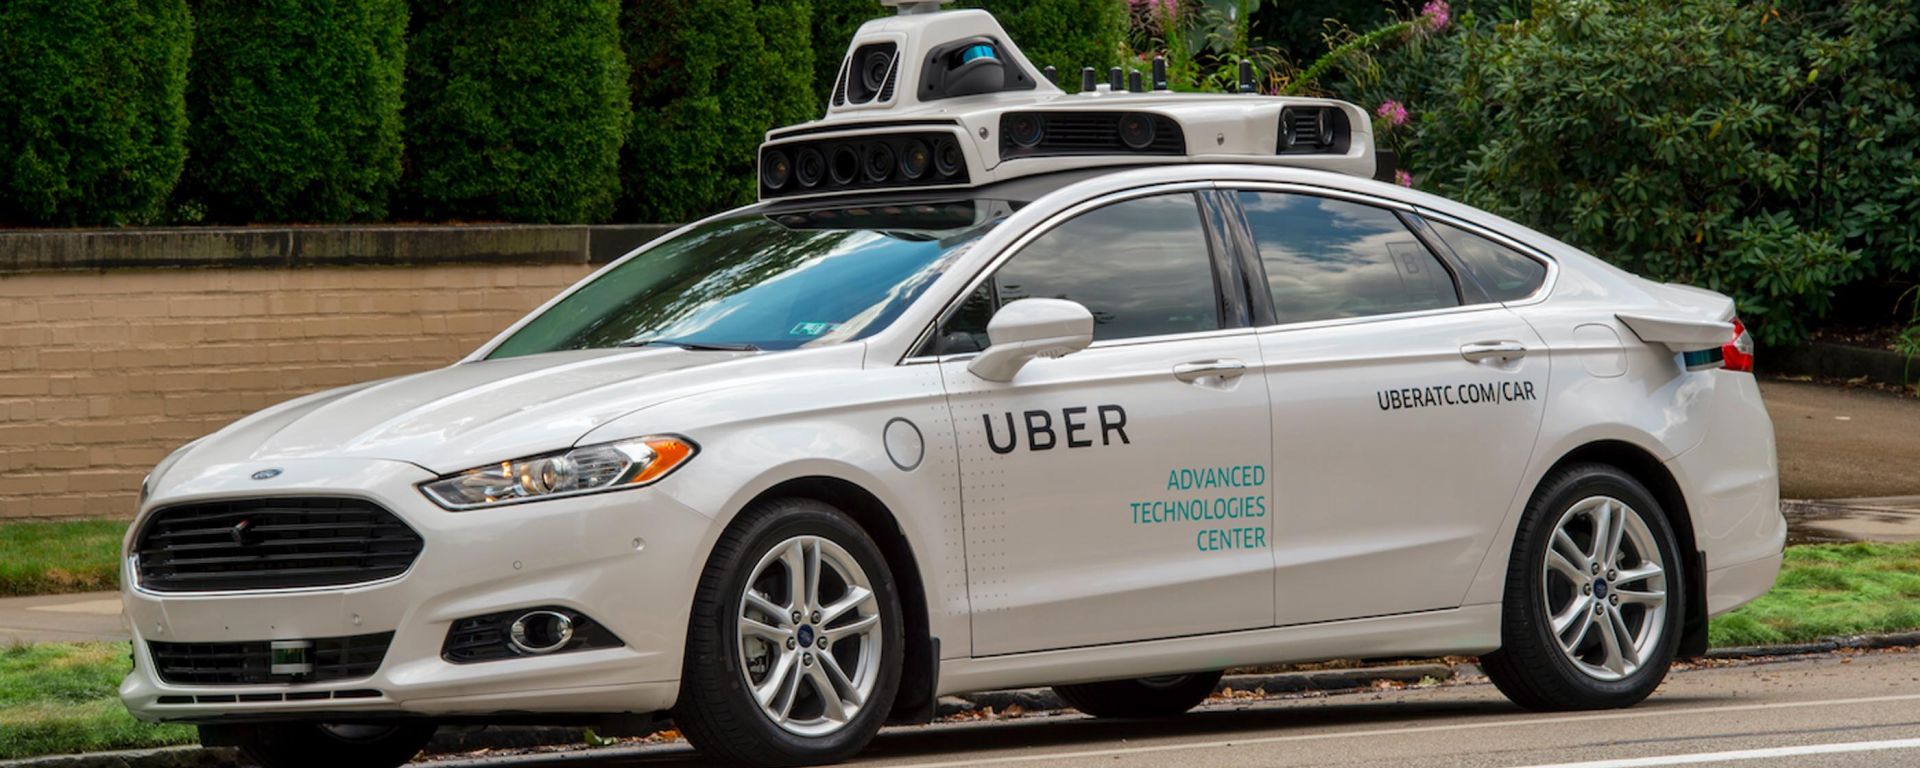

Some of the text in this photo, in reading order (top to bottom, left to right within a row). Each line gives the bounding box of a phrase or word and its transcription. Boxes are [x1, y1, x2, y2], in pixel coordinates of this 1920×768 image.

[1377, 381, 1537, 411] UBERATC.COM/CAR
[982, 404, 1131, 454] UBER
[1166, 464, 1265, 491] ADVANCED
[1130, 496, 1266, 524] TECHNOLOGIES
[1196, 527, 1266, 552] CENTER
